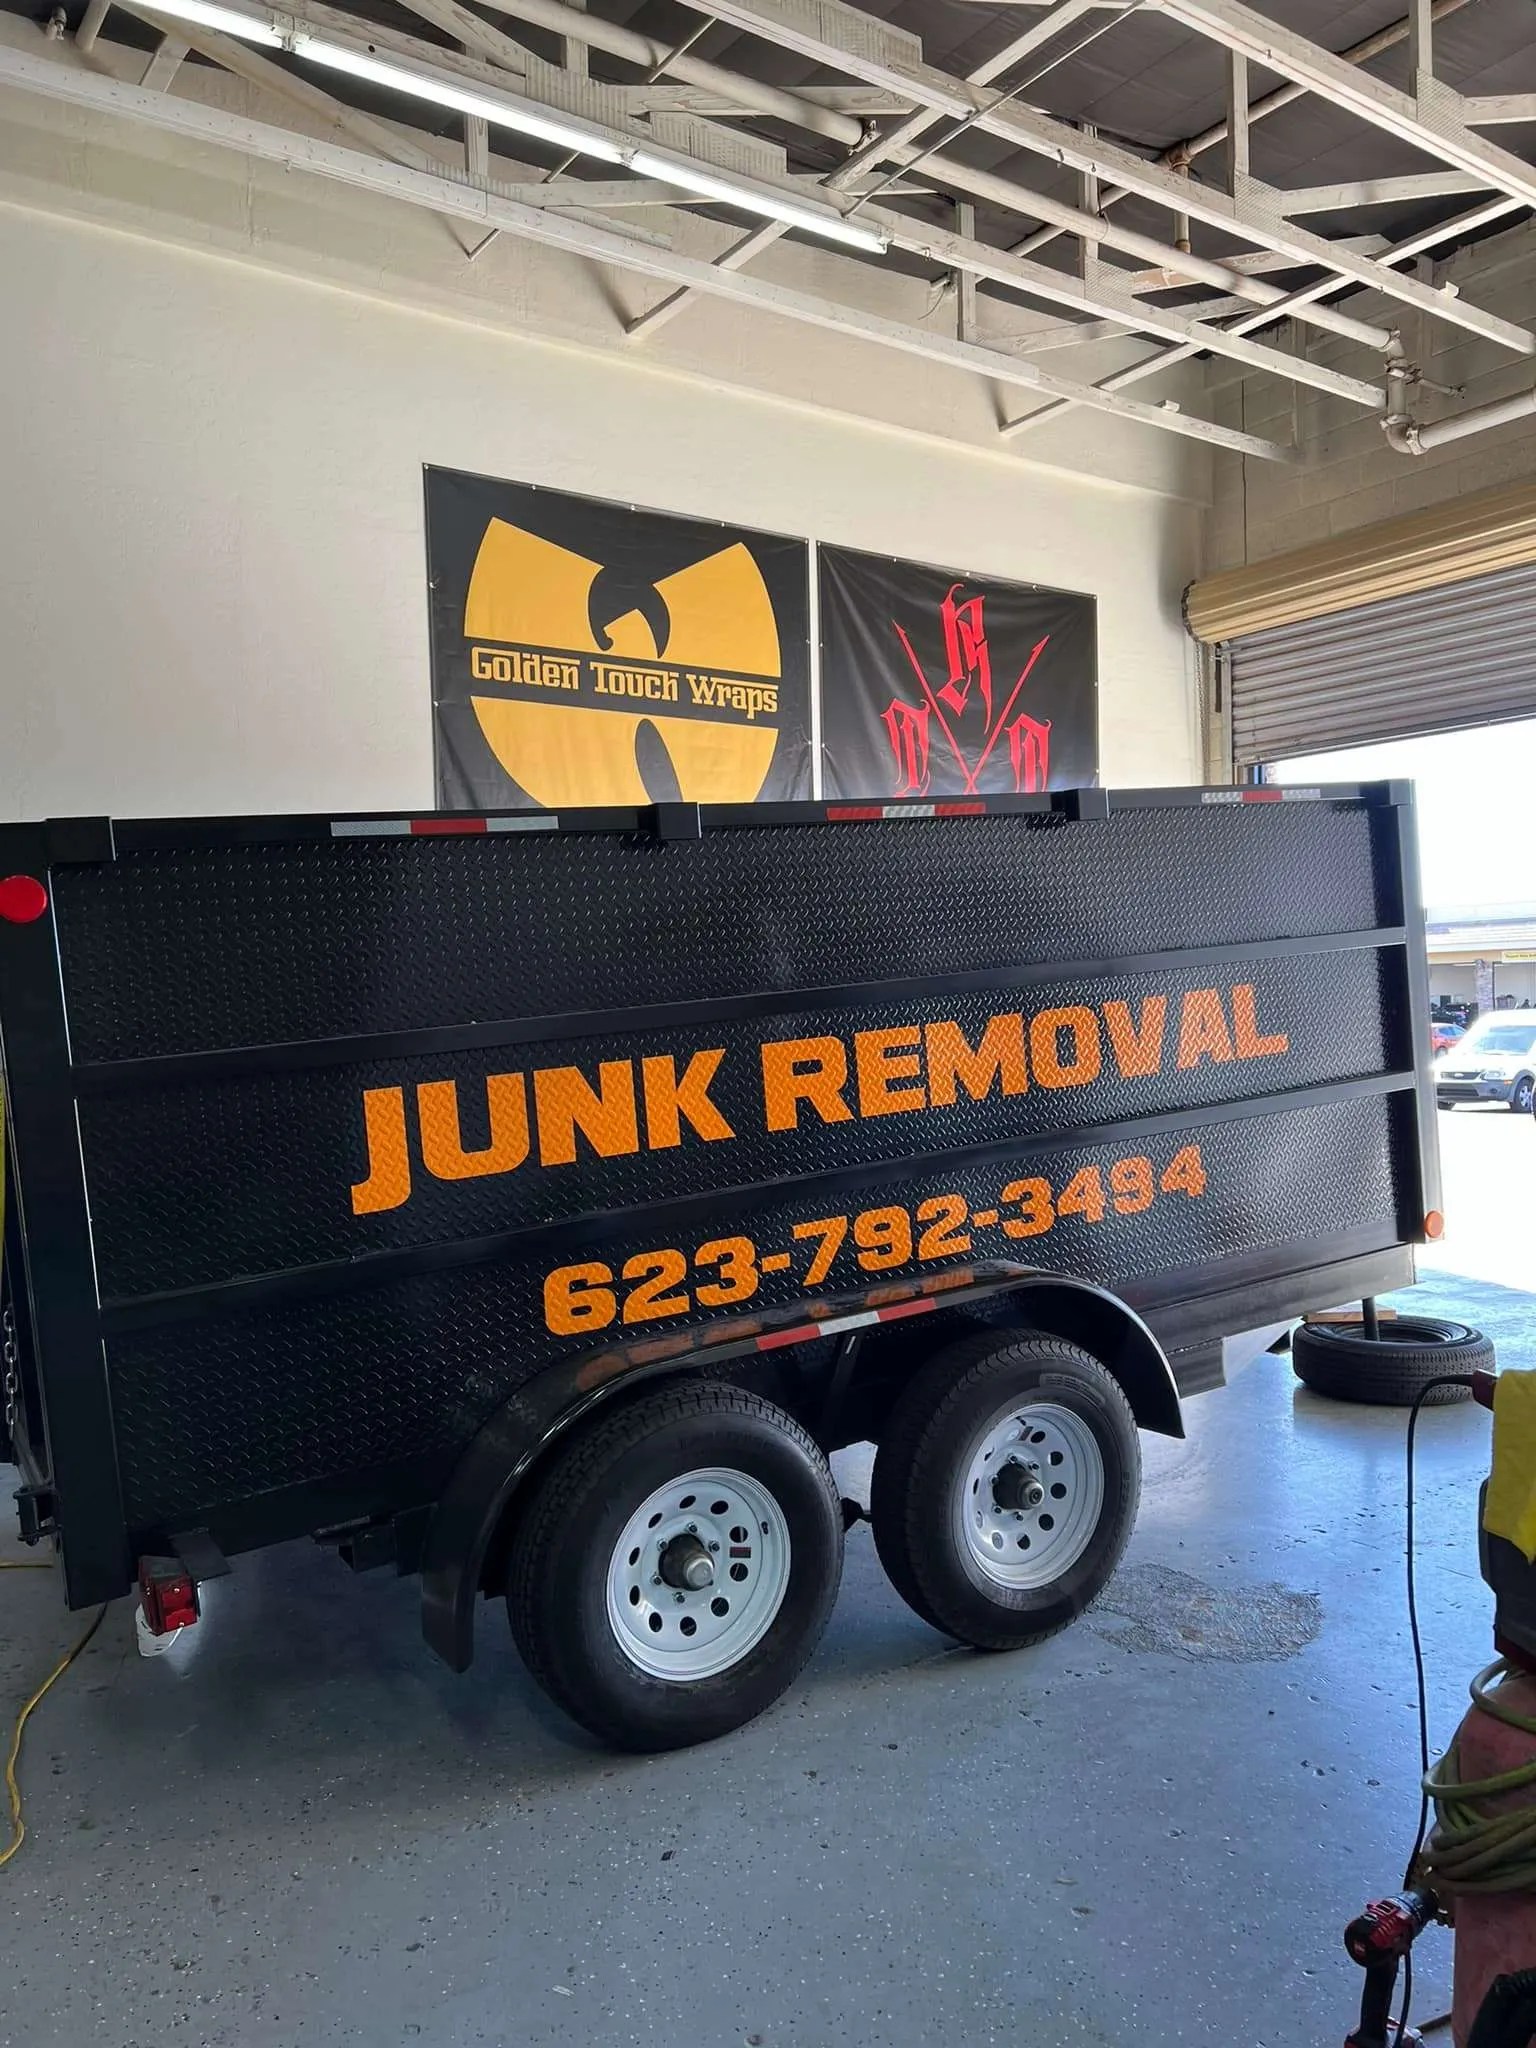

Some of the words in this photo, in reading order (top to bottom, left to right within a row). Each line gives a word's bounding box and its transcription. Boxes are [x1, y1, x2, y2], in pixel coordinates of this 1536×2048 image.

[470, 646, 581, 690] Golden
[589, 661, 680, 702] Touch
[686, 673, 780, 720] Wraps
[350, 1048, 736, 1216] JUNK
[760, 984, 1289, 1132] REMOVAL
[542, 1144, 1207, 1337] 623-792-3494
